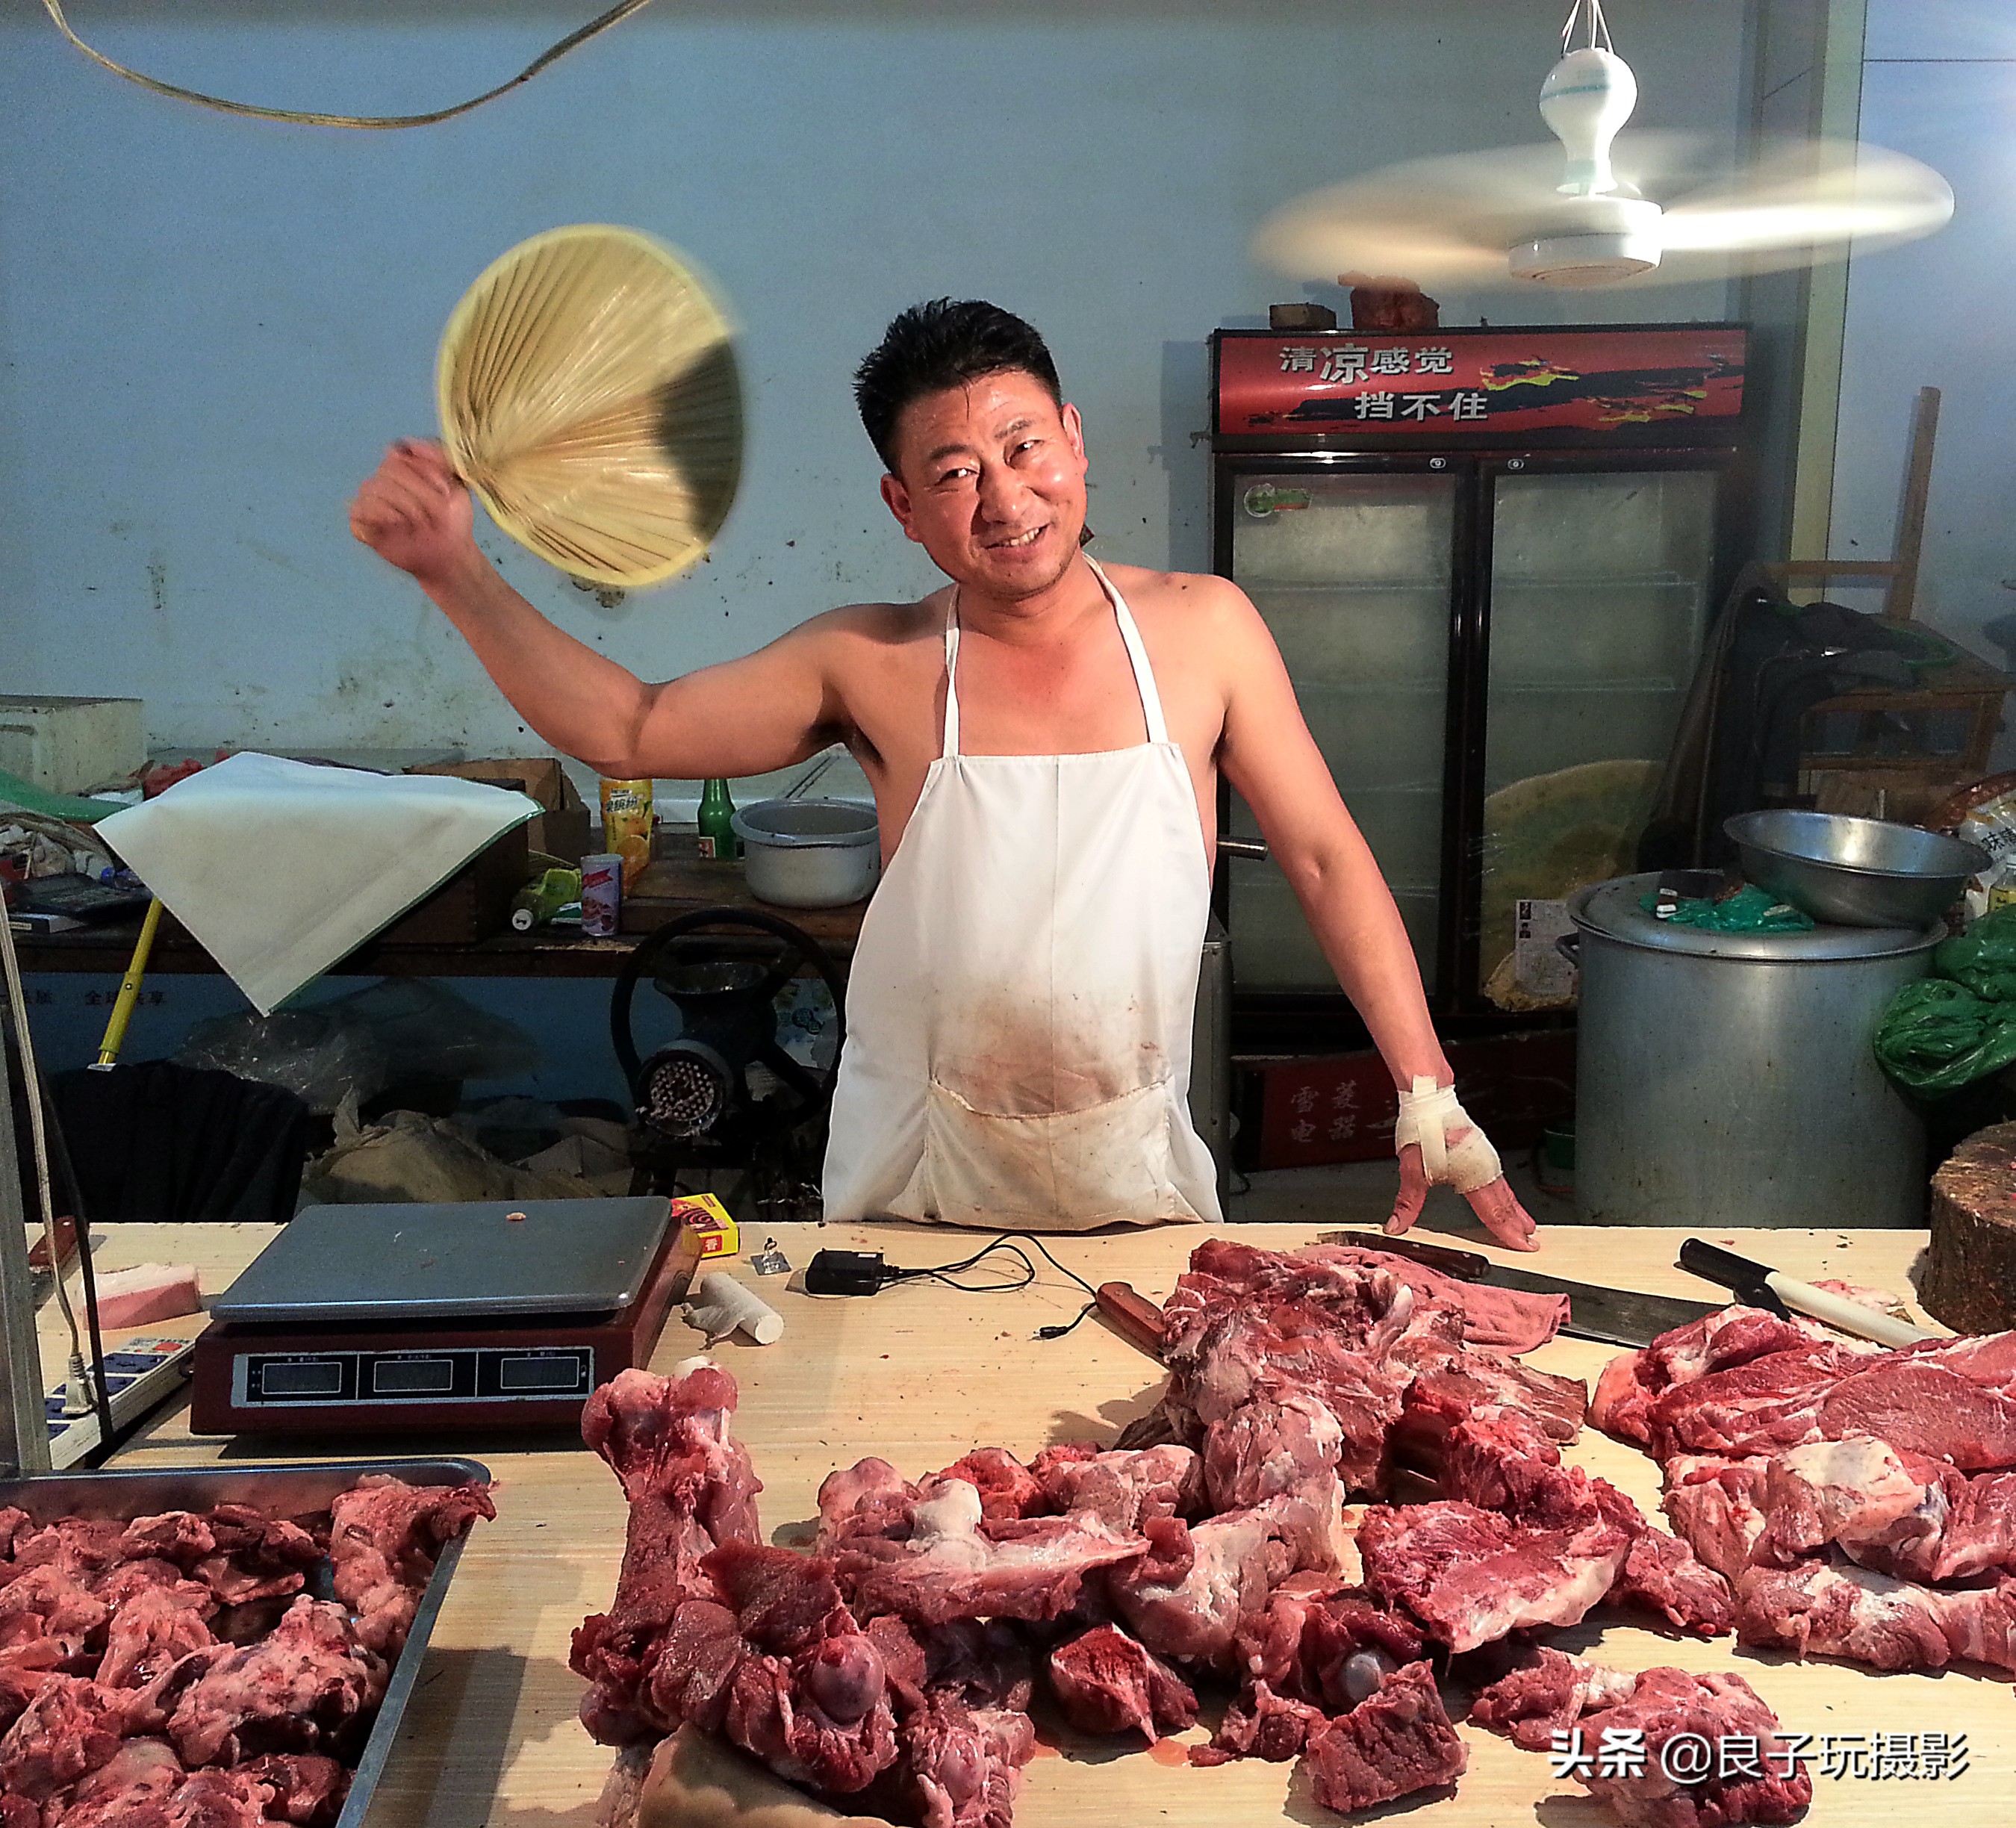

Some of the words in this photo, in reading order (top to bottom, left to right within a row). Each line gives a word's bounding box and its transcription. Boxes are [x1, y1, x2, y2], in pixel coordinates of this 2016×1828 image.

[1279, 343, 1453, 383] 清凉感觉
[1354, 391, 1488, 421] 挡不住
